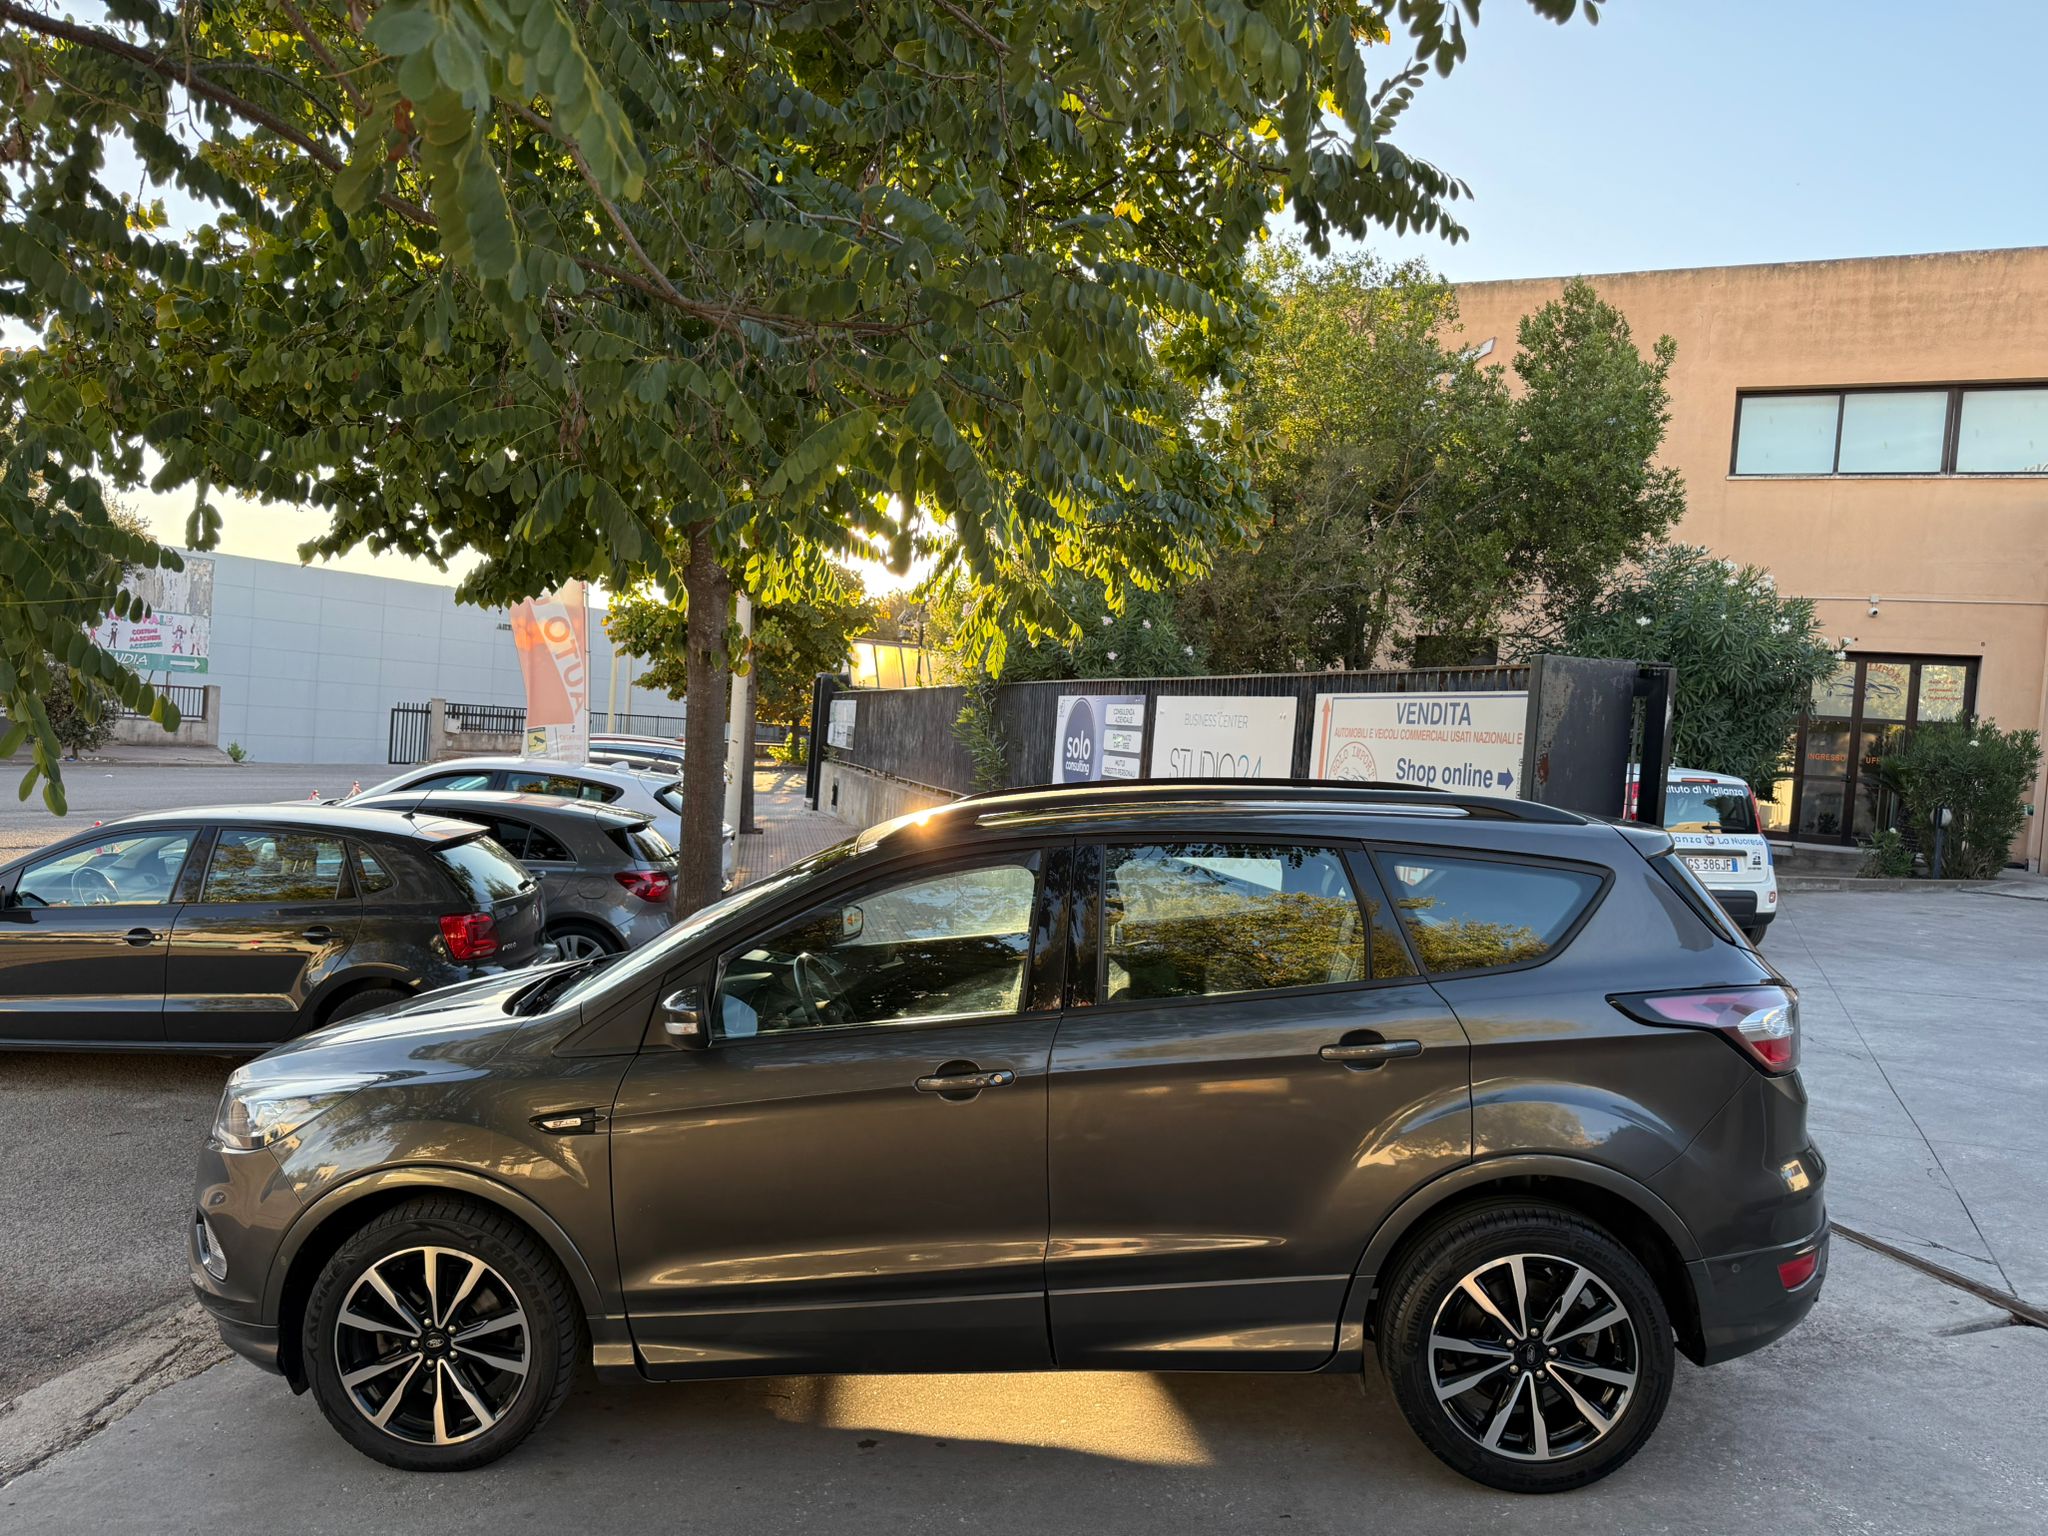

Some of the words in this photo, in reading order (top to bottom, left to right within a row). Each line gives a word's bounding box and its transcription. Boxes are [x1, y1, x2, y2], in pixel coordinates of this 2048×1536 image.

[1184, 713, 1217, 728] BUSINESS
[1218, 714, 1249, 729] CENTER
[1396, 702, 1472, 726] VENDITA
[1334, 727, 1368, 739] AUTOMOBILI
[1369, 729, 1374, 739] E
[1375, 729, 1399, 740] VEICOLI
[1400, 729, 1449, 742] COMMERCIALI
[1450, 730, 1472, 743] USATI
[1473, 732, 1515, 744] NAZIONALI
[1517, 733, 1523, 744] E
[1066, 730, 1091, 760] solo
[1807, 753, 1846, 763] INGRESSO
[1065, 761, 1090, 776] consulting
[1396, 757, 1437, 787] Shop
[1441, 763, 1493, 788] online
[1692, 785, 1701, 794] di
[1702, 784, 1744, 797] Vigilanza
[1717, 837, 1730, 845] La
[1731, 837, 1764, 846] Nuorese
[1703, 858, 1731, 870] 386JF
